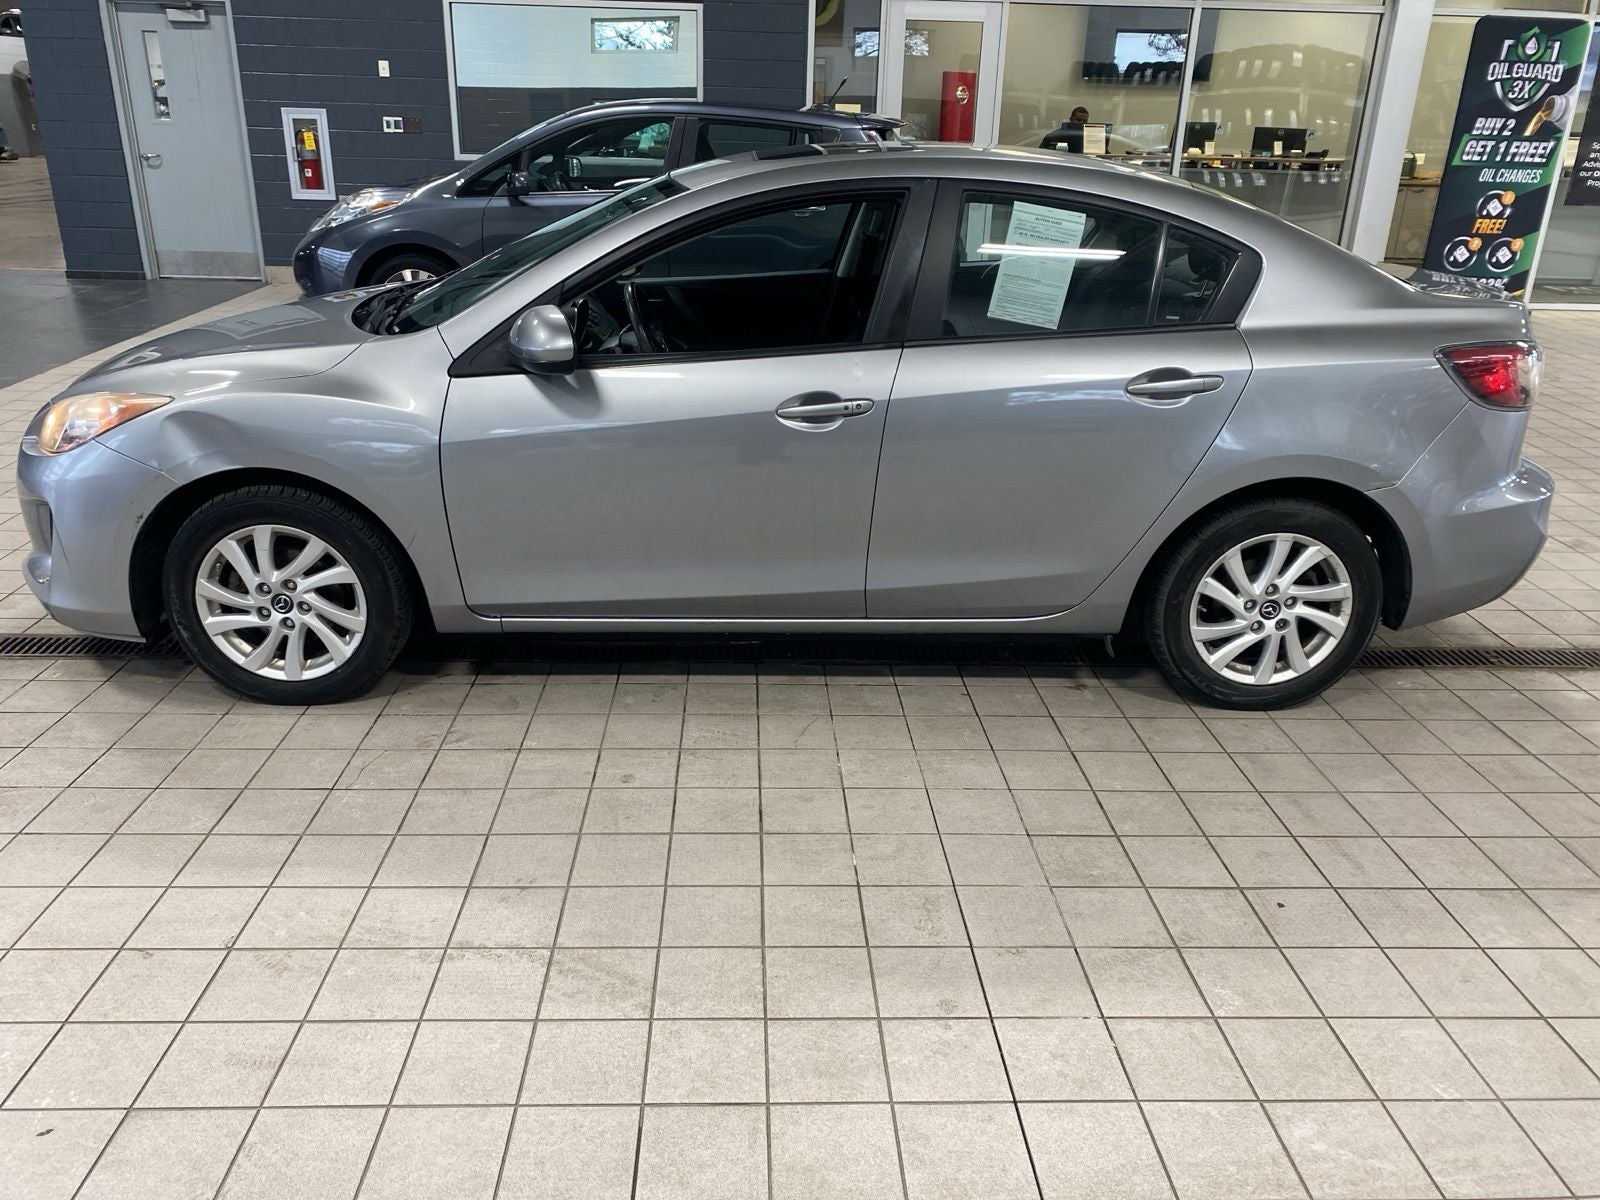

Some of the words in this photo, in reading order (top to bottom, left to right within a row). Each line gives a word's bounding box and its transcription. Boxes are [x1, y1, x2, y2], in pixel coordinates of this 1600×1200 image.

[1487, 62, 1511, 80] OIL
[1512, 62, 1564, 82] GUARD
[1508, 80, 1536, 99] 3X
[1471, 117, 1506, 135] BUY
[1502, 118, 1517, 136] 2
[1462, 140, 1496, 161] GET
[1495, 140, 1508, 162] 1
[1505, 140, 1556, 163] FREE!
[1479, 168, 1496, 182] OIL
[1496, 168, 1543, 184] CHANGES
[1587, 179, 1600, 188] Pro
[1472, 218, 1507, 234] FREE!
